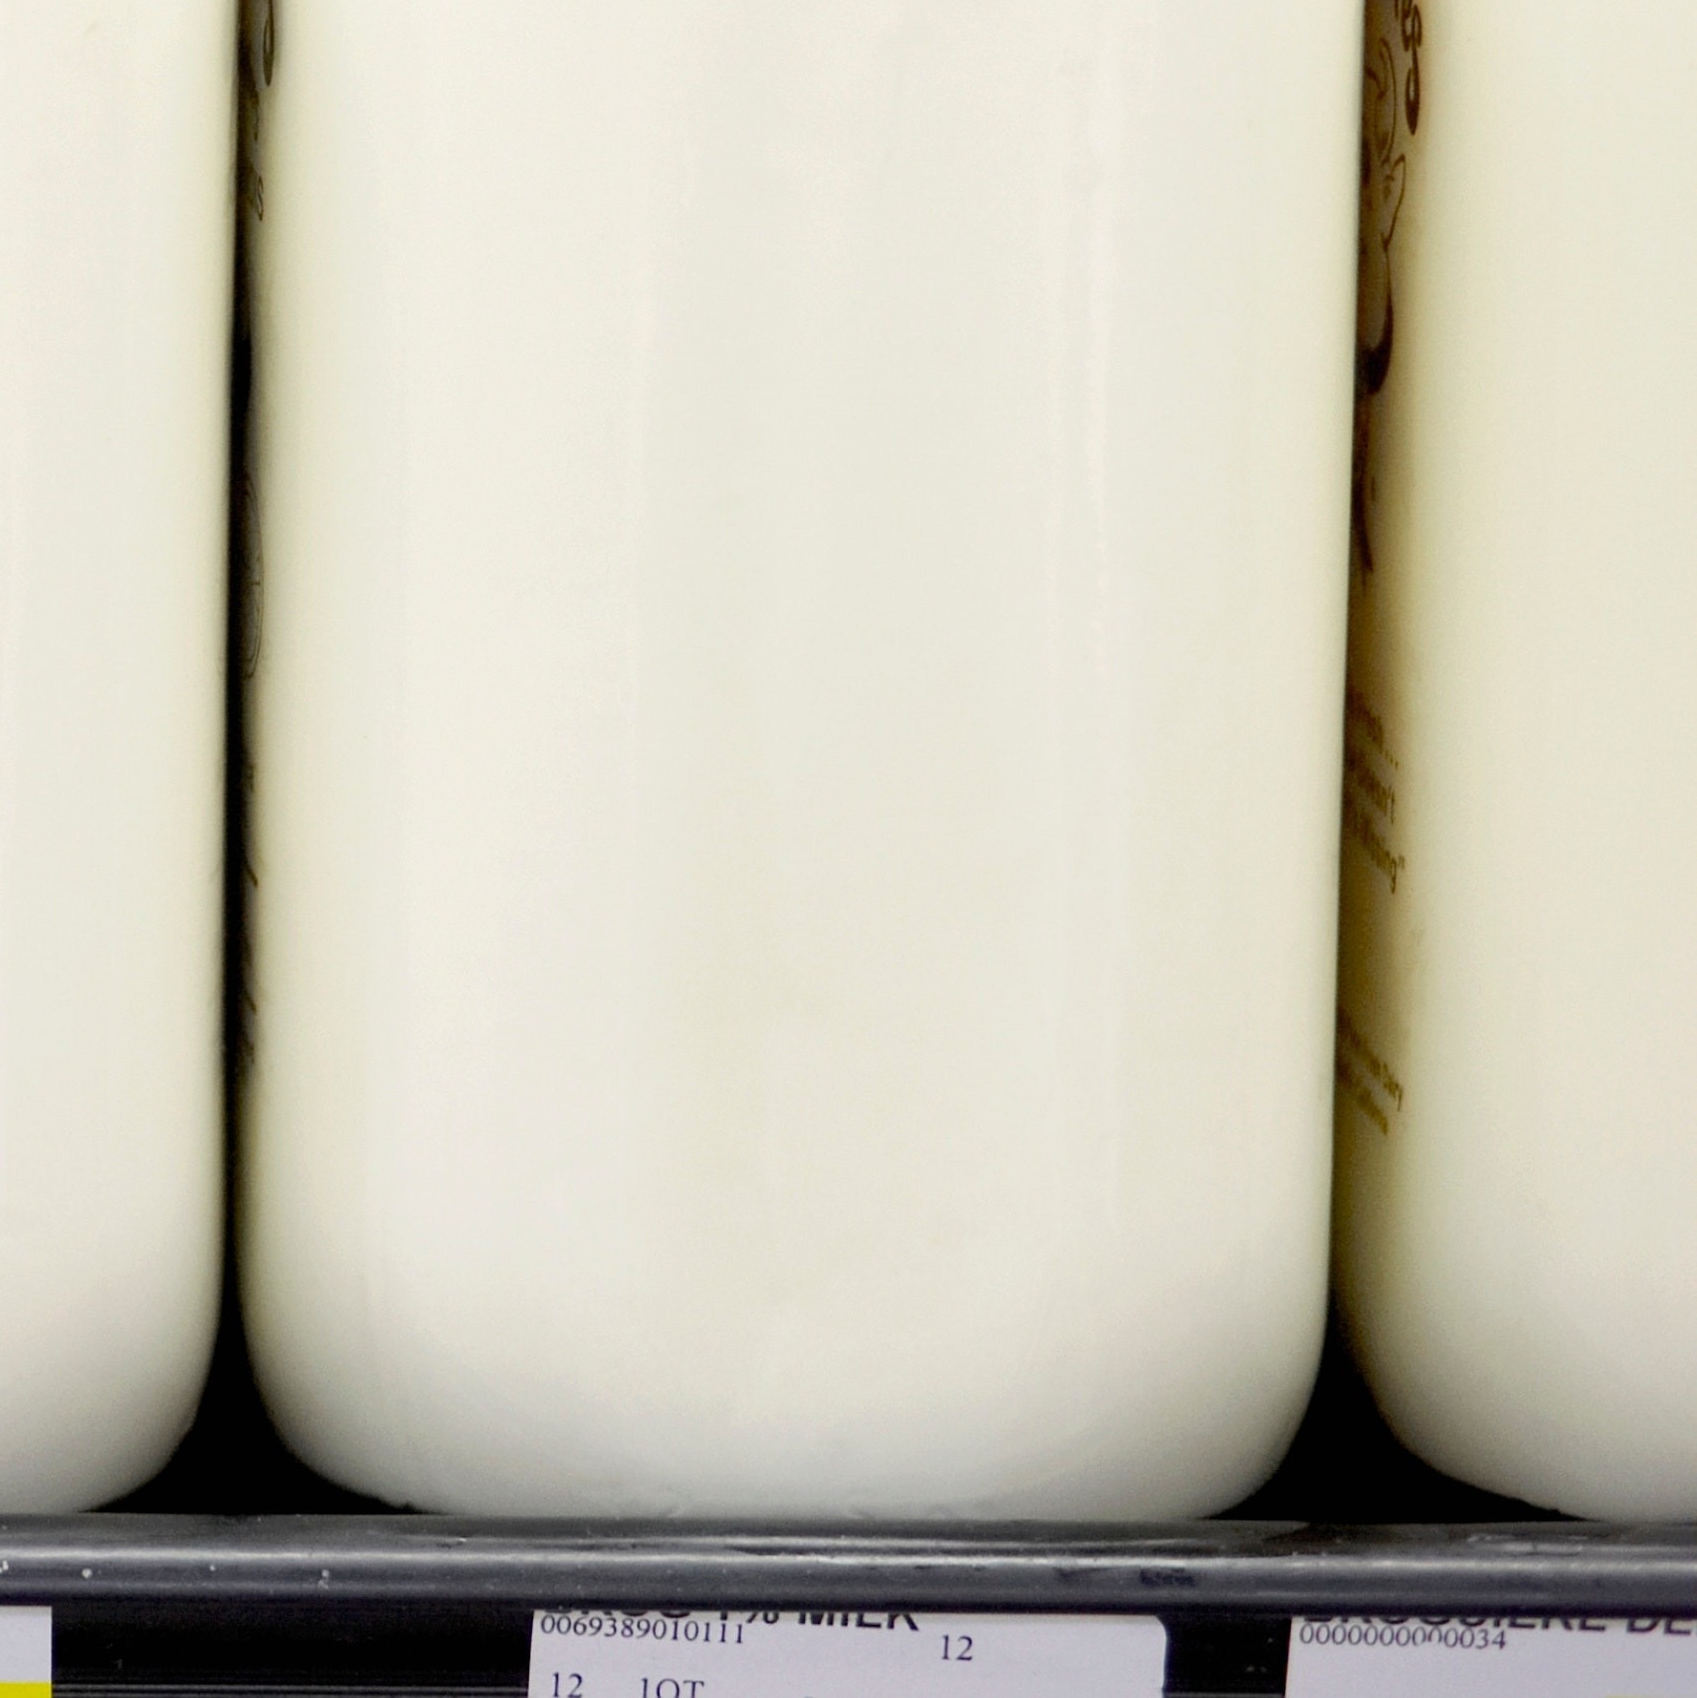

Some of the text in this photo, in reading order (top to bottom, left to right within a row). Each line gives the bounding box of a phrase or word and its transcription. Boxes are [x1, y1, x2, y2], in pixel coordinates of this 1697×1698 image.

[540, 1614, 744, 1644] 0069389010111
[941, 1634, 973, 1661] 12
[551, 1672, 584, 1698] 12
